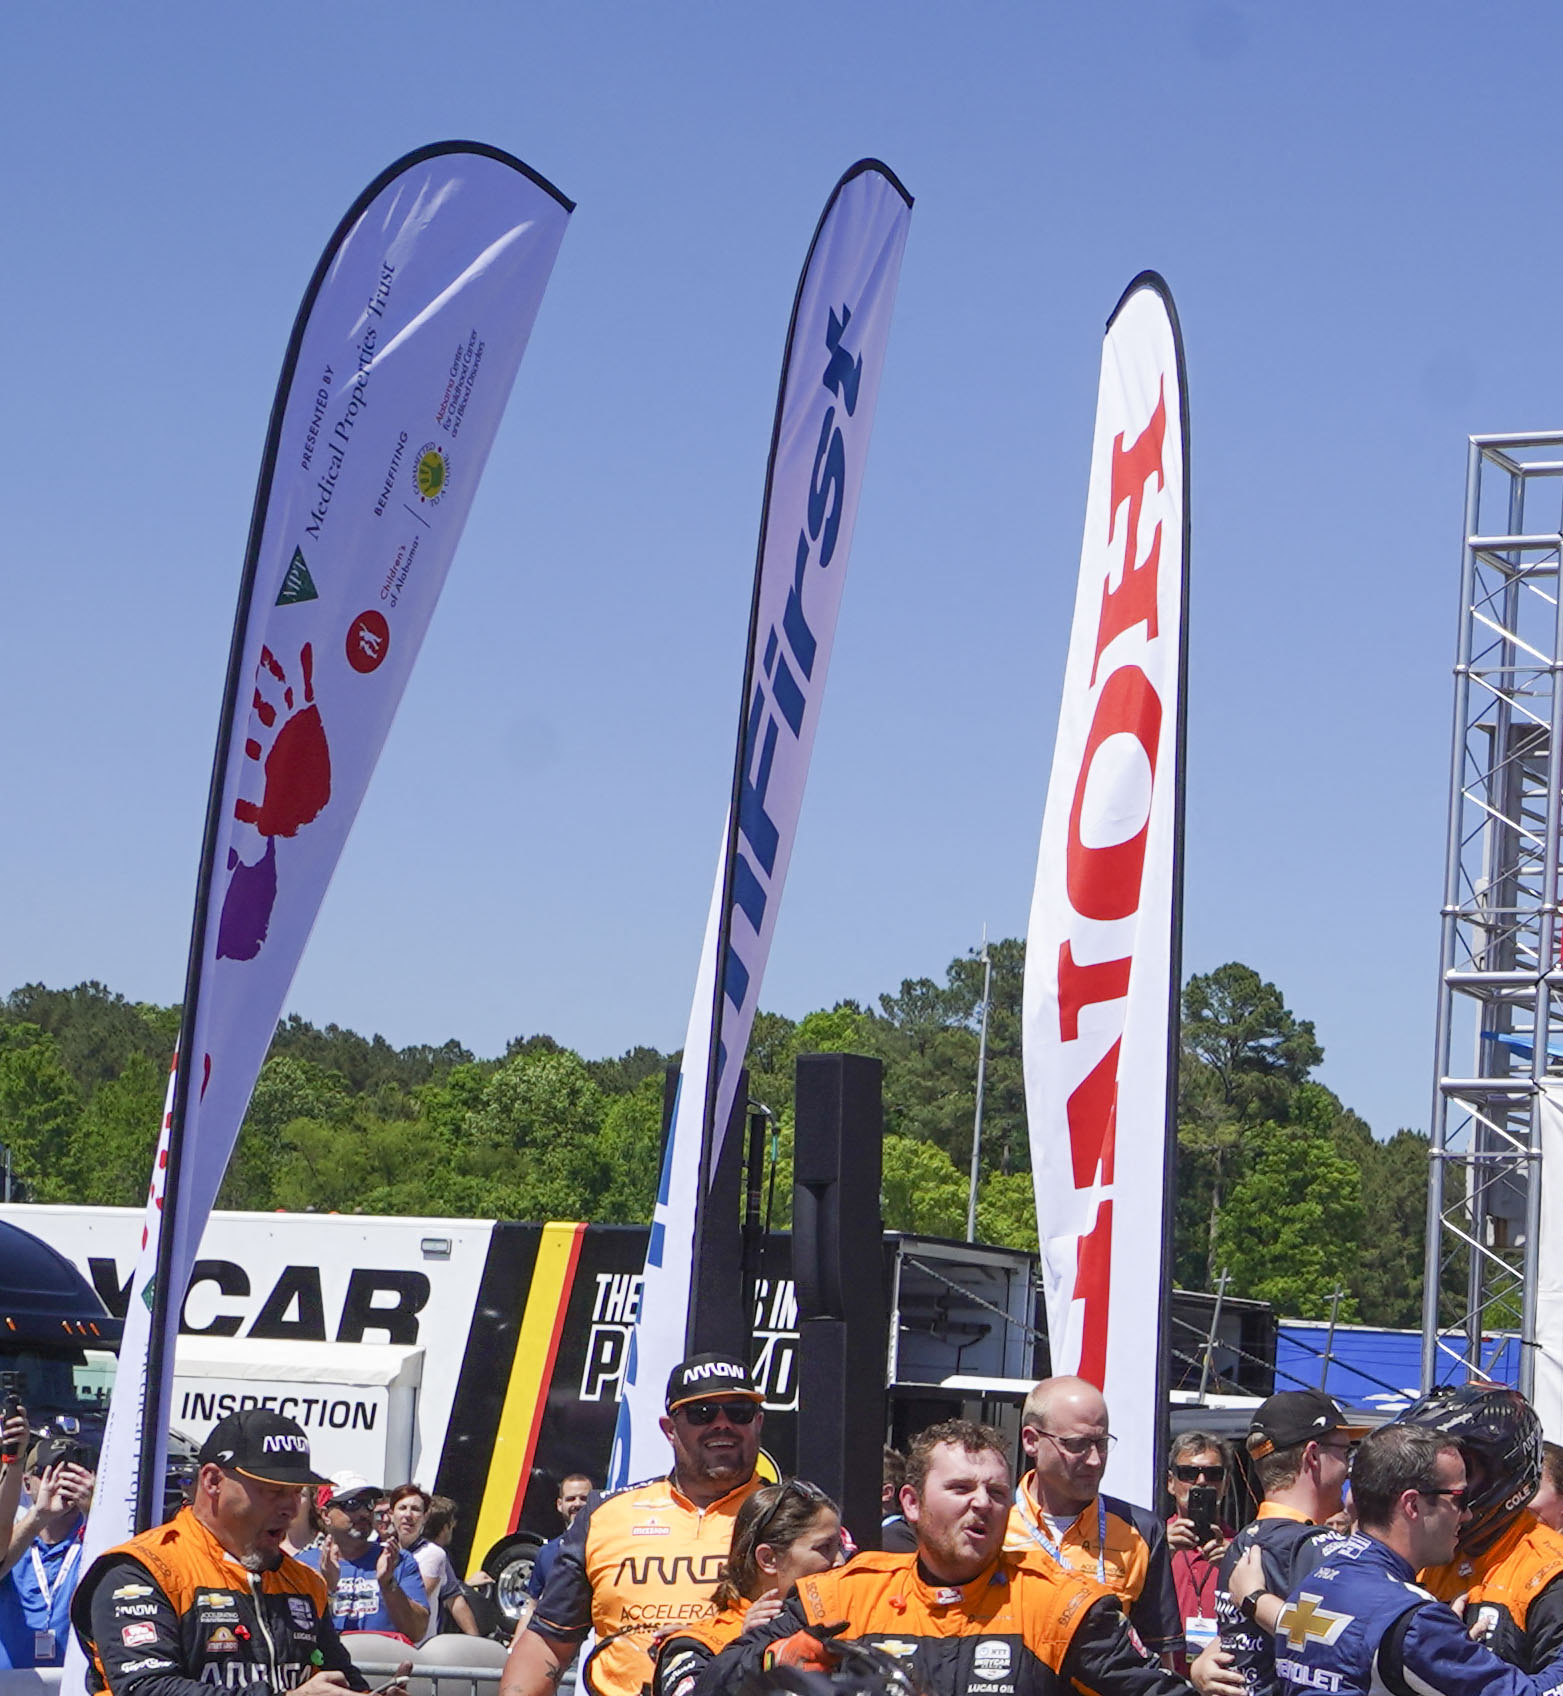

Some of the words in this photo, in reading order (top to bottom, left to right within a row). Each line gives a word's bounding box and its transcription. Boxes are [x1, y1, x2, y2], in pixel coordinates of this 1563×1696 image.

[305, 443, 345, 541] Medical
[334, 326, 378, 443] Properties
[366, 263, 396, 320] Trust
[436, 380, 455, 425] Alabama
[450, 344, 464, 380] Center
[448, 366, 470, 417] Childhood
[463, 328, 478, 367] Cancer
[457, 384, 471, 416] Blood
[466, 341, 486, 386] Disorders
[301, 388, 328, 471] PRESENTED
[324, 364, 335, 386] BY
[374, 431, 409, 517] BENEFITING
[395, 535, 421, 594] Alabama
[592, 1273, 644, 1323] THE
[1505, 1486, 1531, 1512] COLE
[968, 1683, 998, 1693] LUCAS
